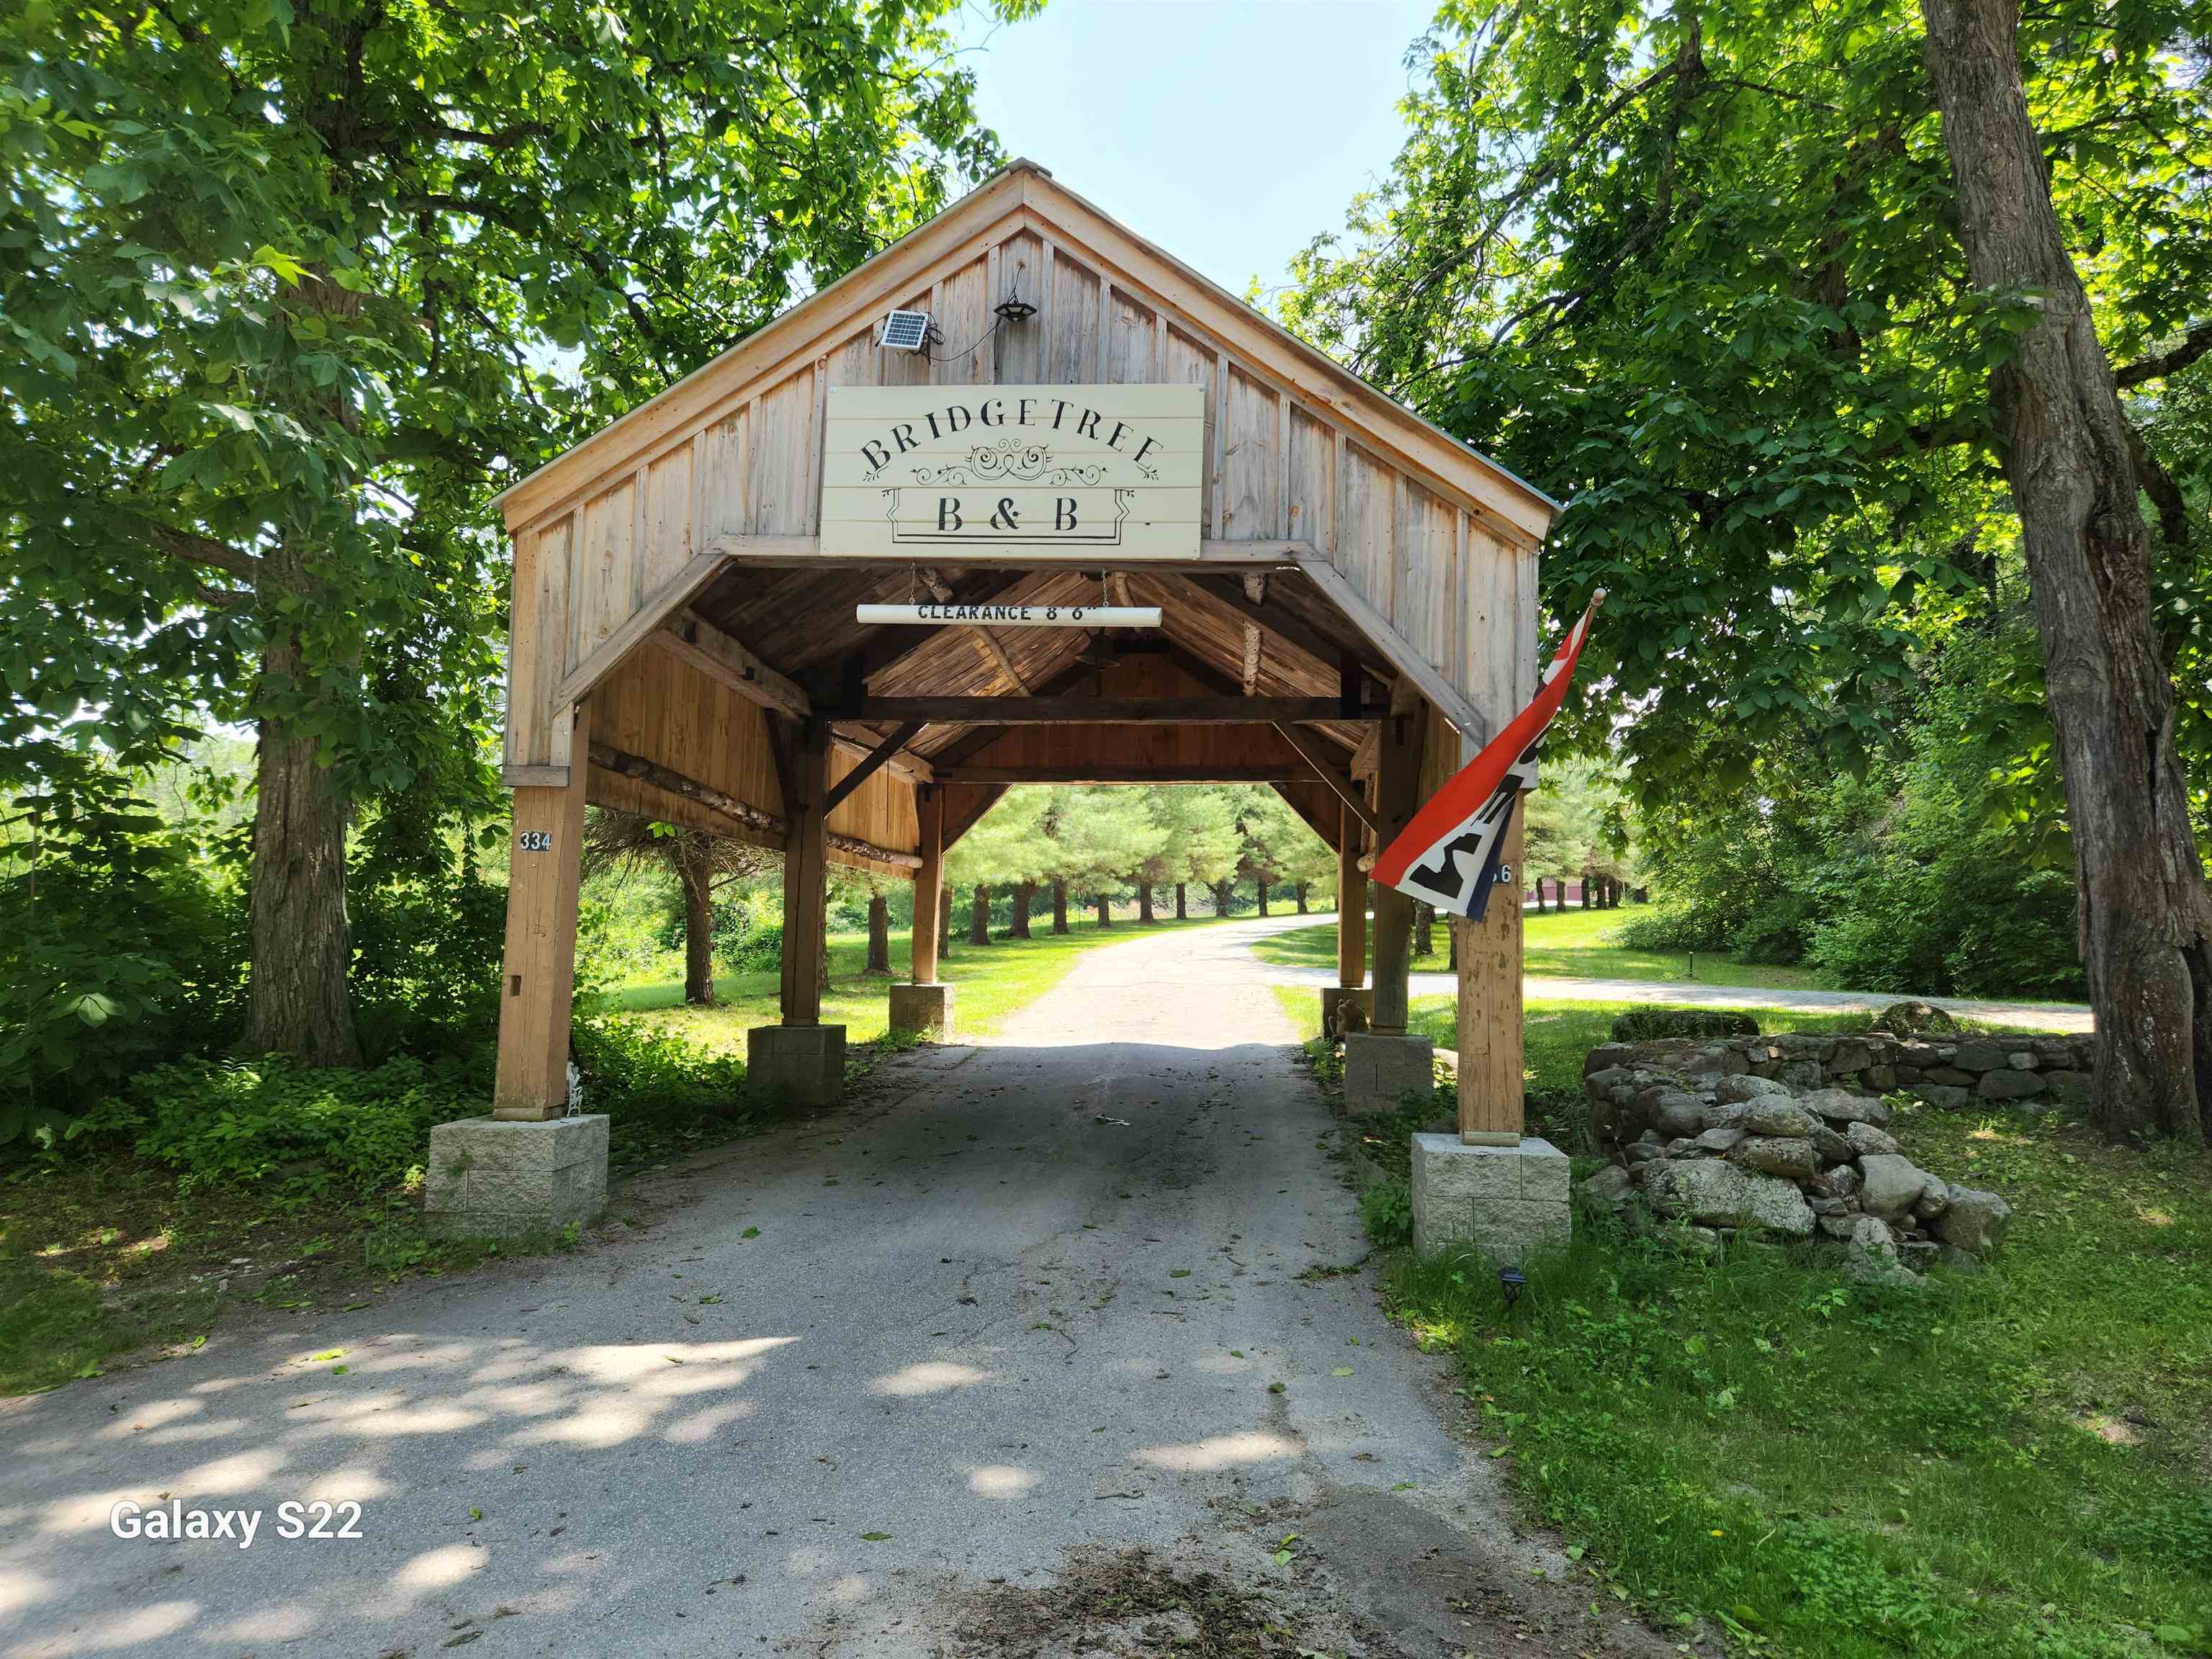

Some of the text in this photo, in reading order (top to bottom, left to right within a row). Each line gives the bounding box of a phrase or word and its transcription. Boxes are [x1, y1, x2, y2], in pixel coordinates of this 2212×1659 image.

[860, 398, 1164, 472] BRIDGETREE
[938, 498, 1078, 531] B & B
[917, 605, 1032, 621] CLEARANCE
[521, 832, 552, 850] 334
